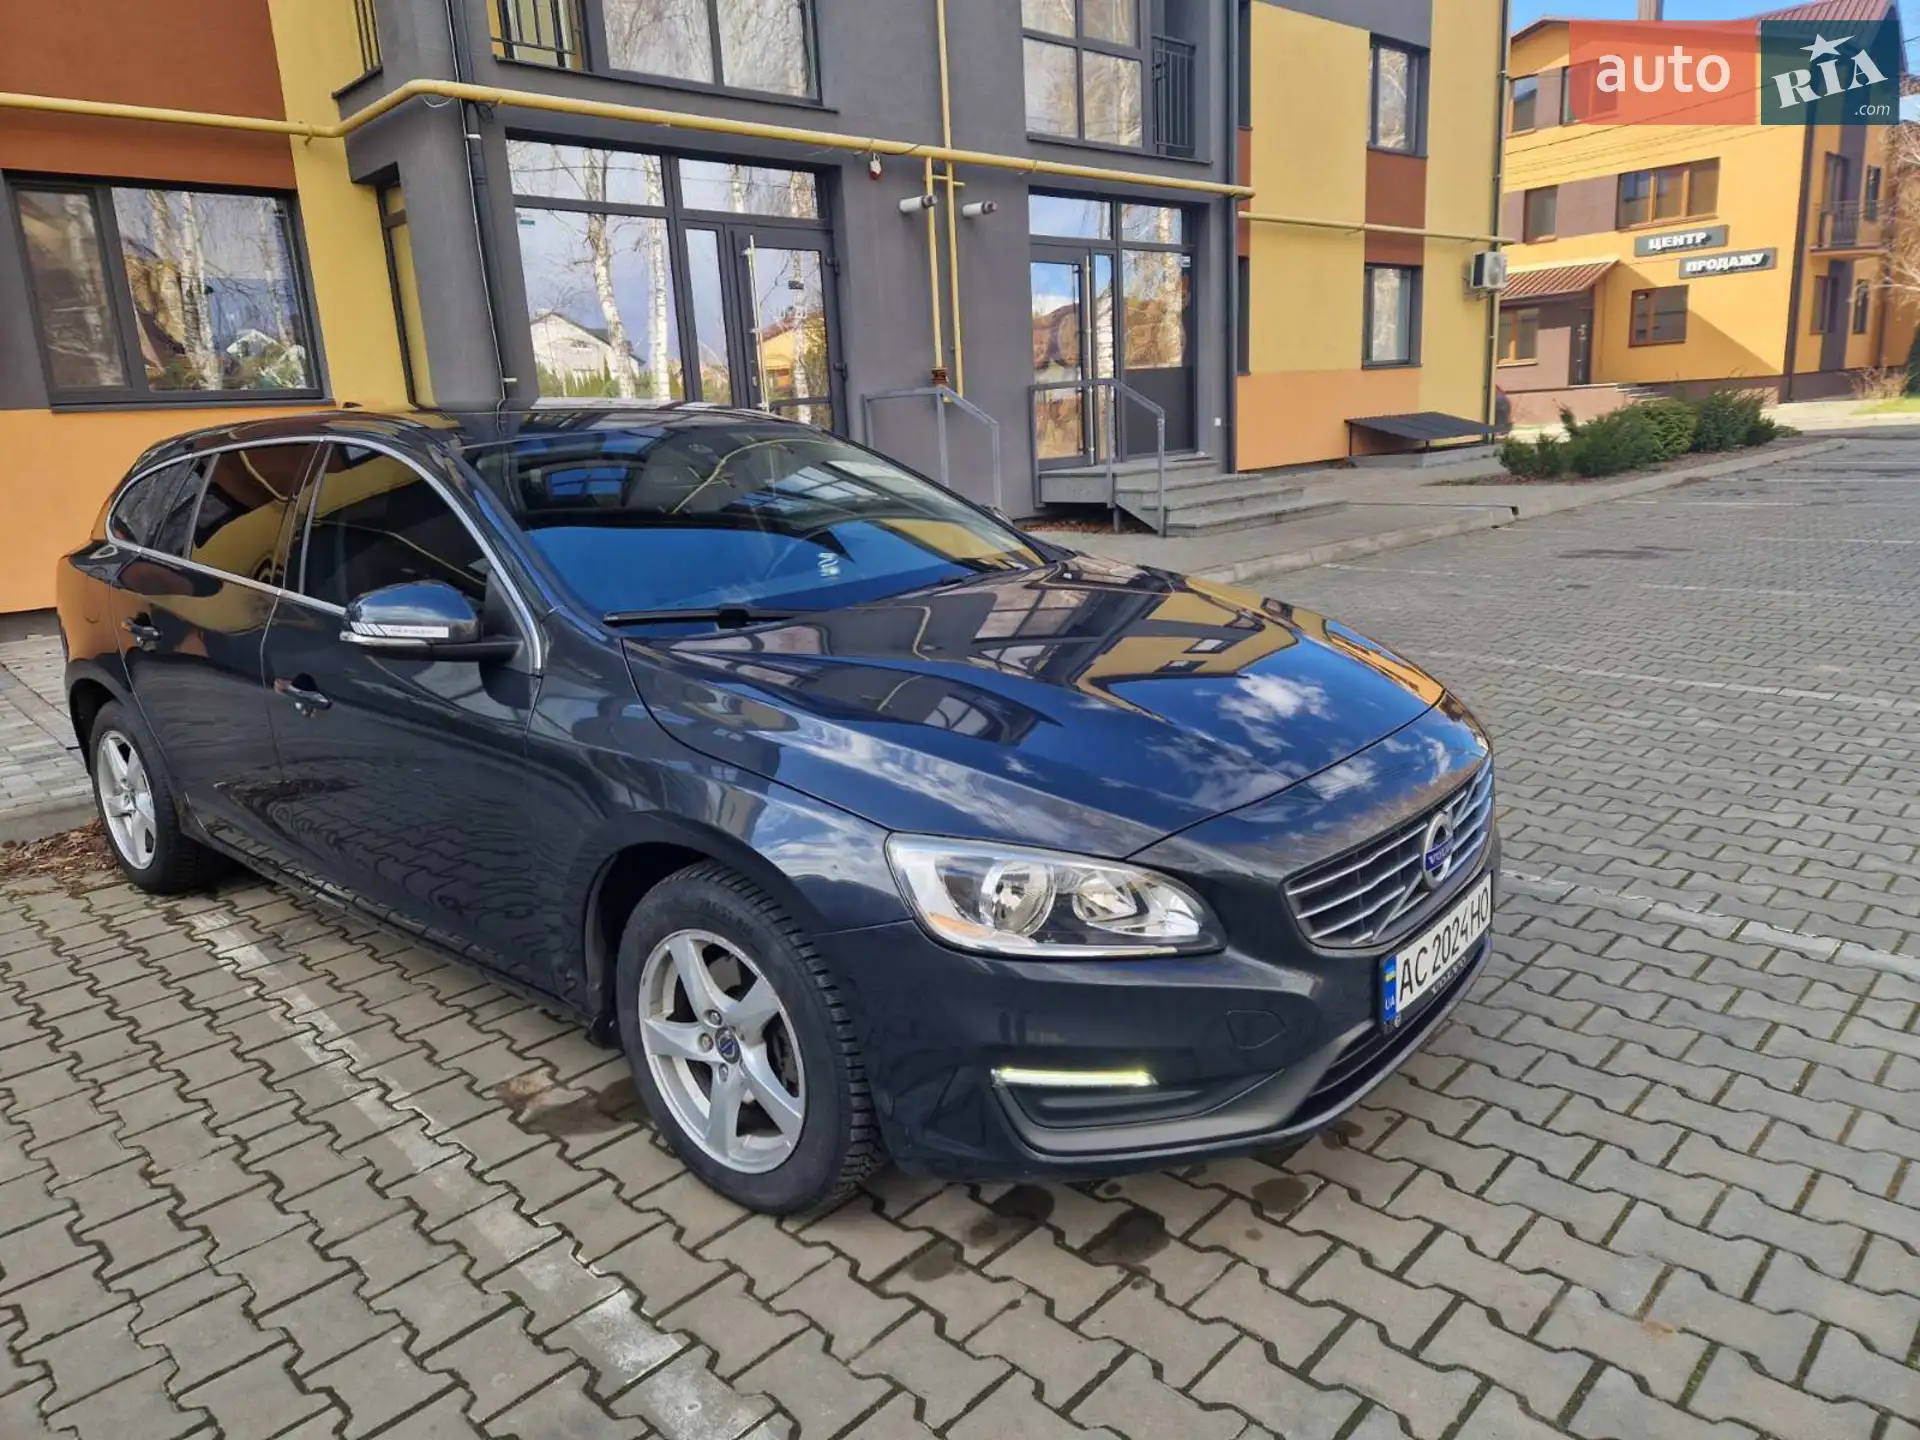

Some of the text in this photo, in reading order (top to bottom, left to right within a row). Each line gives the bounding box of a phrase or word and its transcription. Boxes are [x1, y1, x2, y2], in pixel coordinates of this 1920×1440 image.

[1648, 231, 1708, 251] ЦЕНТР
[1685, 252, 1764, 273] ПРОДАЖУ
[1400, 946, 1428, 1003] AC
[1432, 907, 1469, 976] 2024
[1385, 995, 1395, 1010] UA
